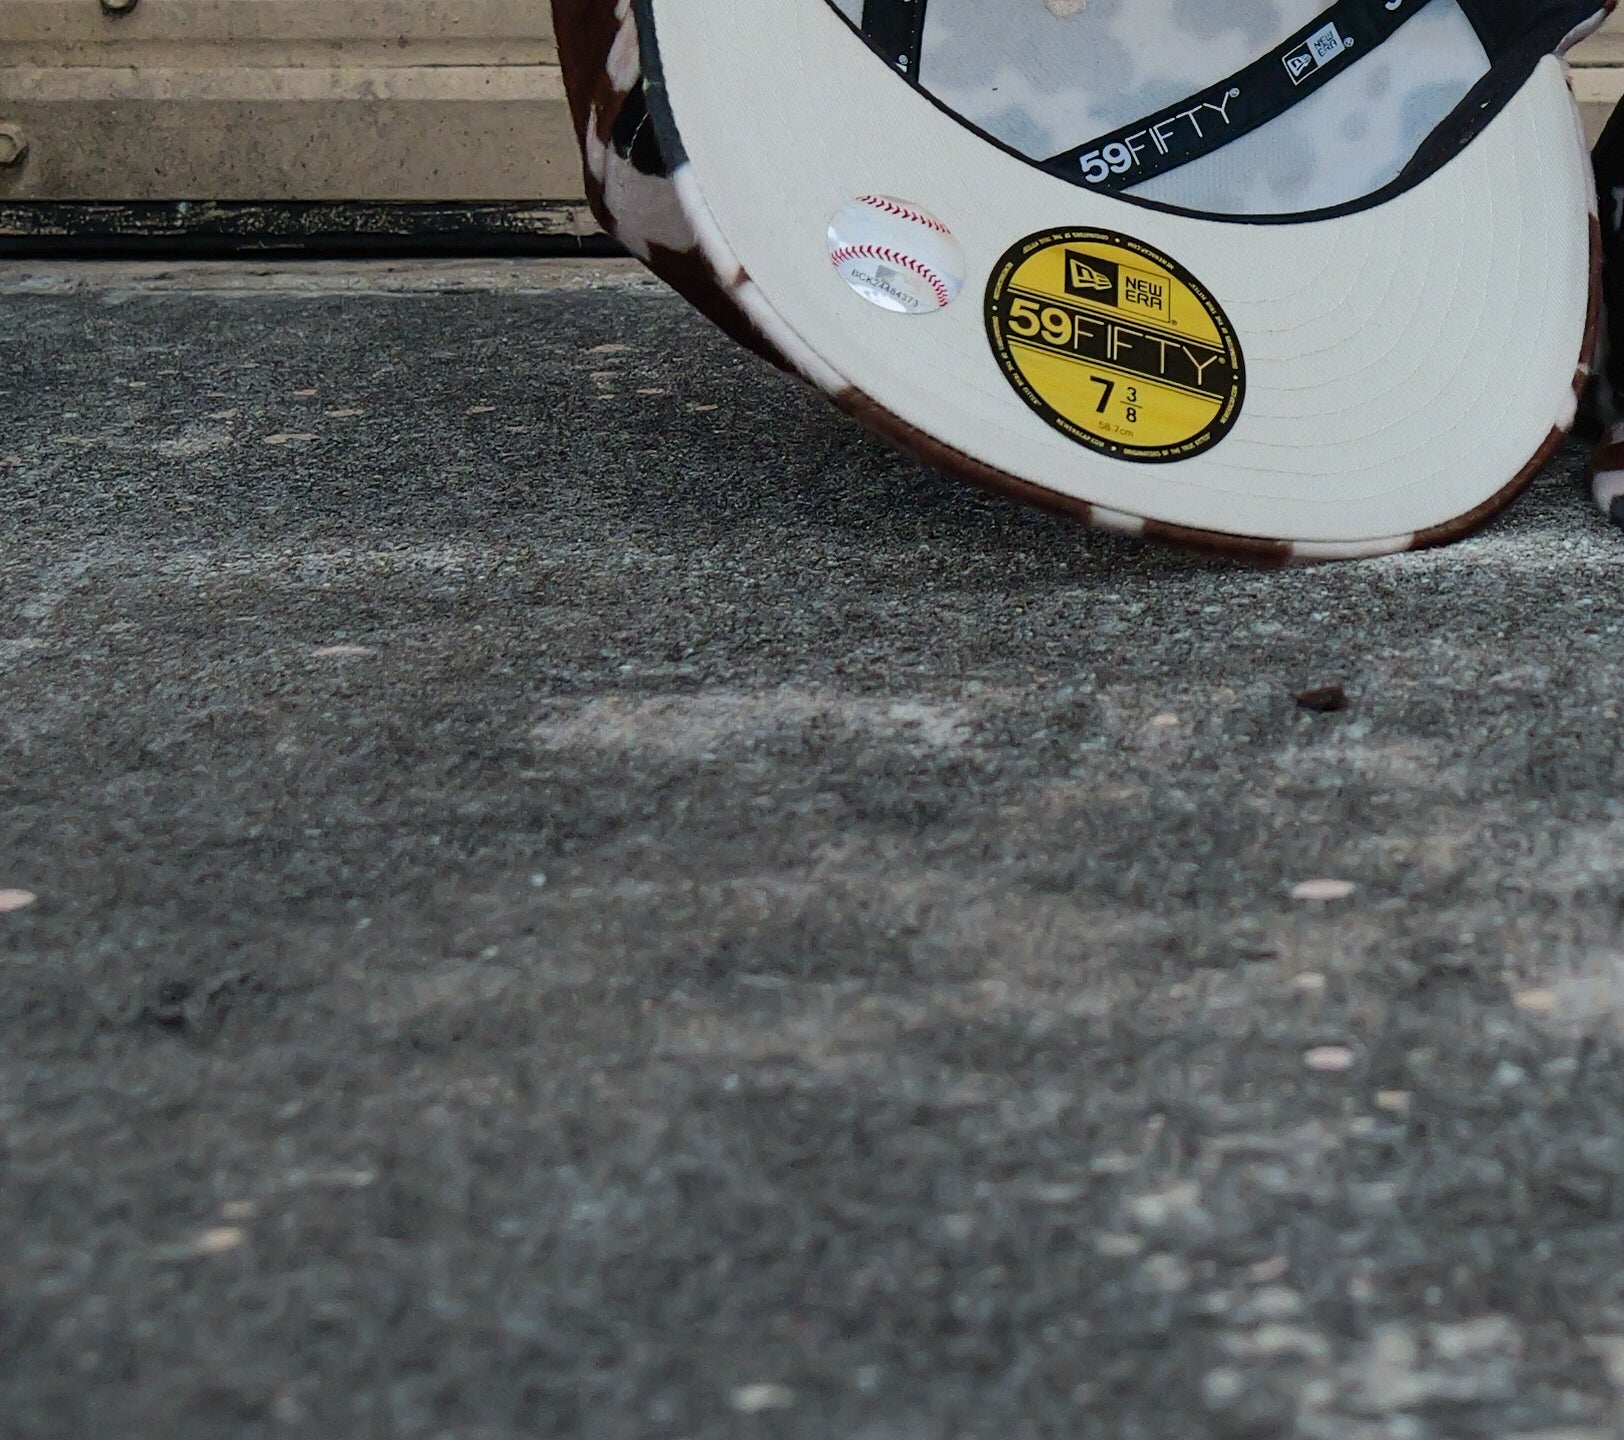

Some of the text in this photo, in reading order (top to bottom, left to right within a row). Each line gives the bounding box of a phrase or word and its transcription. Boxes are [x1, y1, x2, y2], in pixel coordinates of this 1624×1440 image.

[1125, 275, 1163, 299] NEW
[1125, 290, 1163, 311] ERA
[1089, 375, 1115, 414] 7
